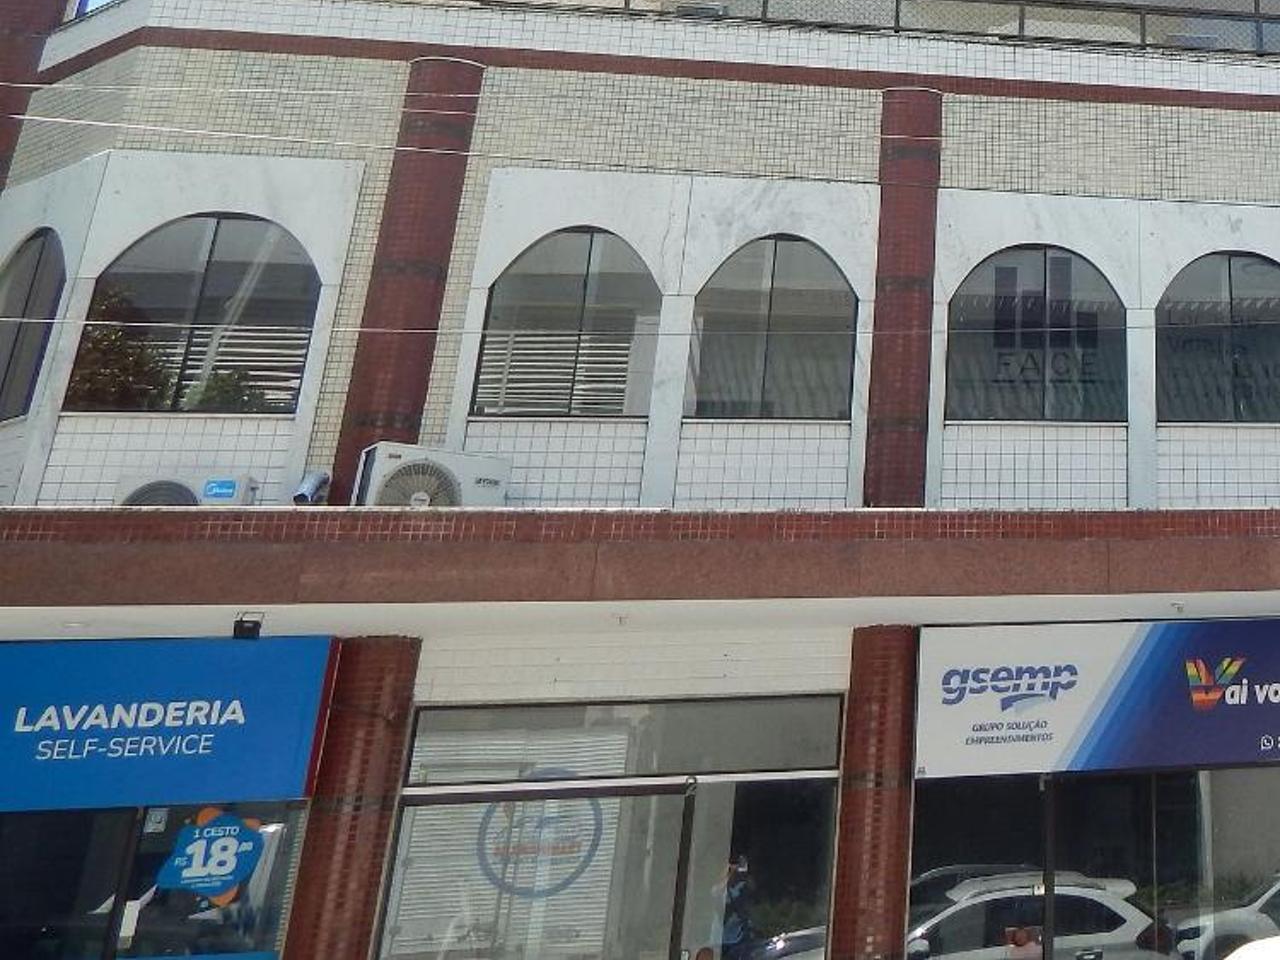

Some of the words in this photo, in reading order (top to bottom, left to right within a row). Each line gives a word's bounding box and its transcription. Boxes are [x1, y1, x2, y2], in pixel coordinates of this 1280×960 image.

[997, 351, 1098, 377] FACE
[941, 664, 1079, 705] gsemp
[14, 699, 246, 732] LAVANDERIA
[972, 722, 1004, 733] GRUPO
[1006, 720, 1048, 732] SOLUÇÃO
[35, 734, 215, 760] SELF-SERVICE
[965, 732, 1054, 746] EMPREENDIMENTOS
[202, 825, 240, 838] CESTO
